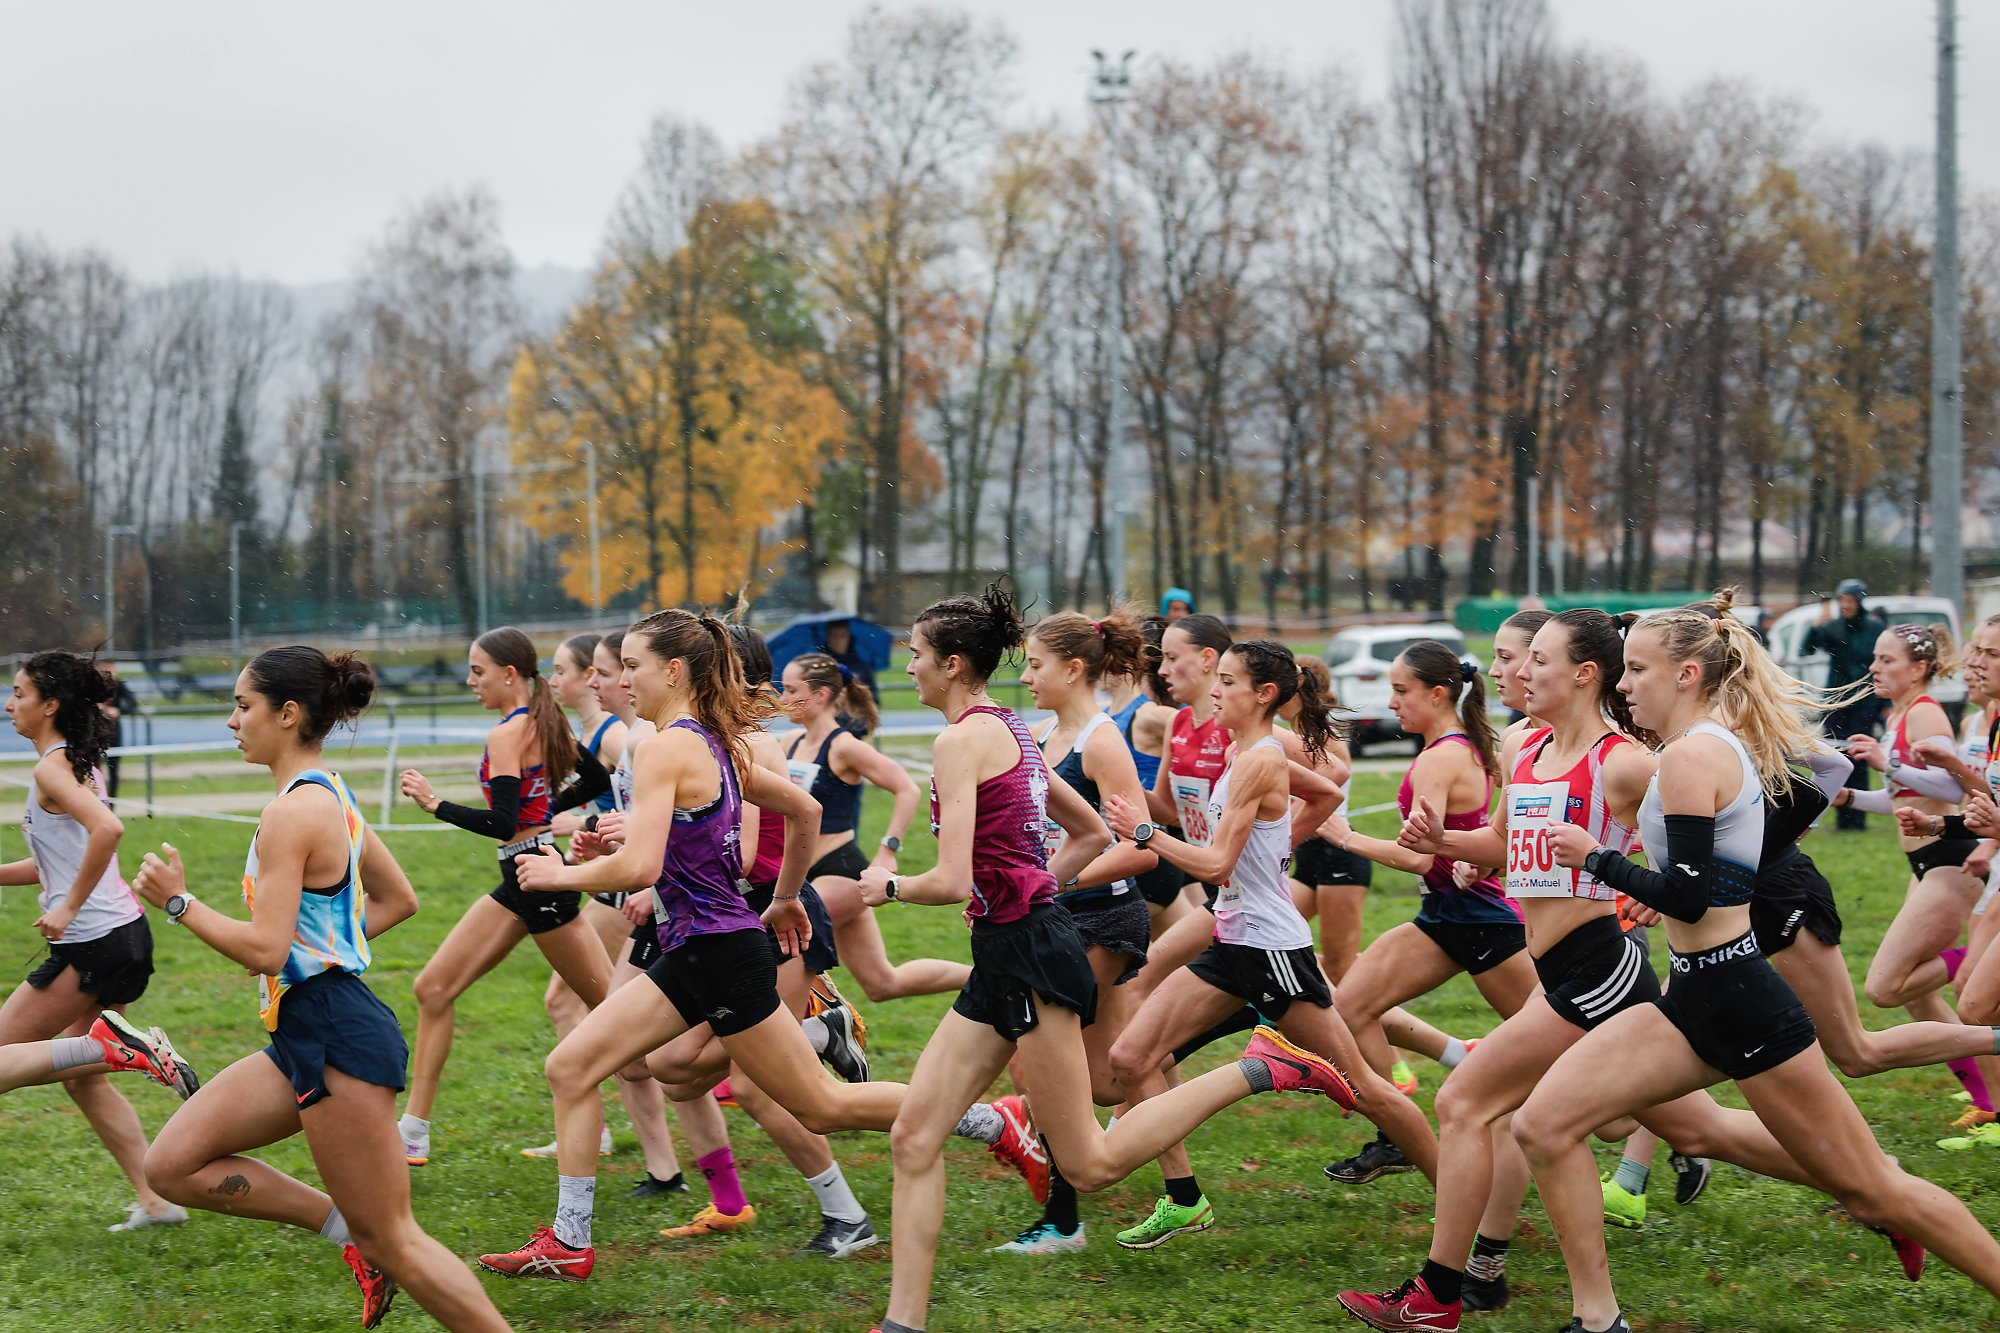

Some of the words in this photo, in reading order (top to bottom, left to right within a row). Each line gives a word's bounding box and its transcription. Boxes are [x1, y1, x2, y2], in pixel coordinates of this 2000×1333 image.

[1184, 806, 1208, 841] 689
[1509, 829, 1553, 872] 550
[1530, 878, 1561, 888] Mutuel
[1698, 935, 1755, 969] NIKE
